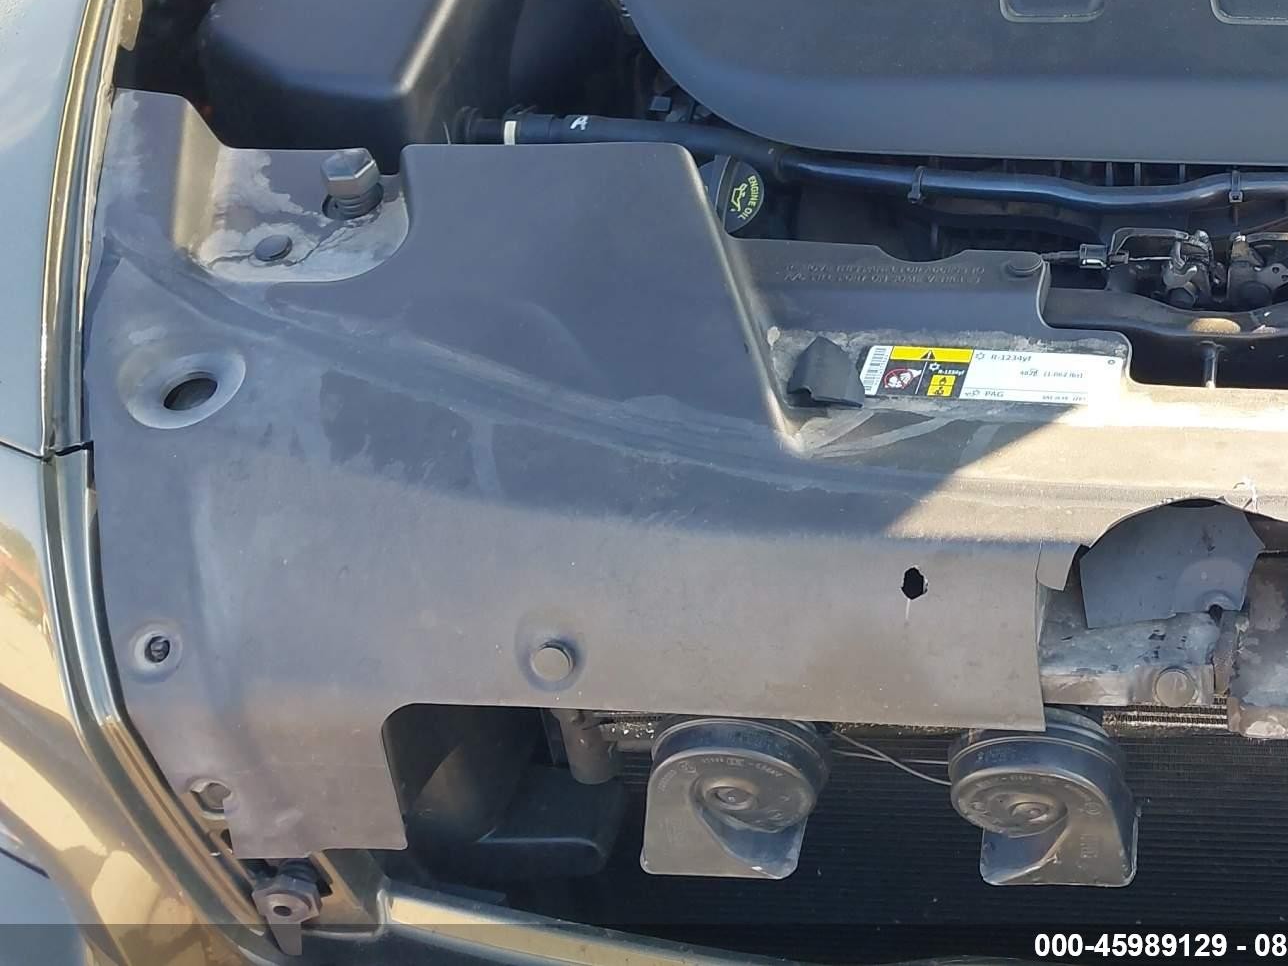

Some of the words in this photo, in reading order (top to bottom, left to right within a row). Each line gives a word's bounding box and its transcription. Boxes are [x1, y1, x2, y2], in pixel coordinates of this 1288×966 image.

[747, 175, 760, 207] ENGINE
[737, 207, 753, 220] OIL
[984, 389, 1004, 398] PAG
